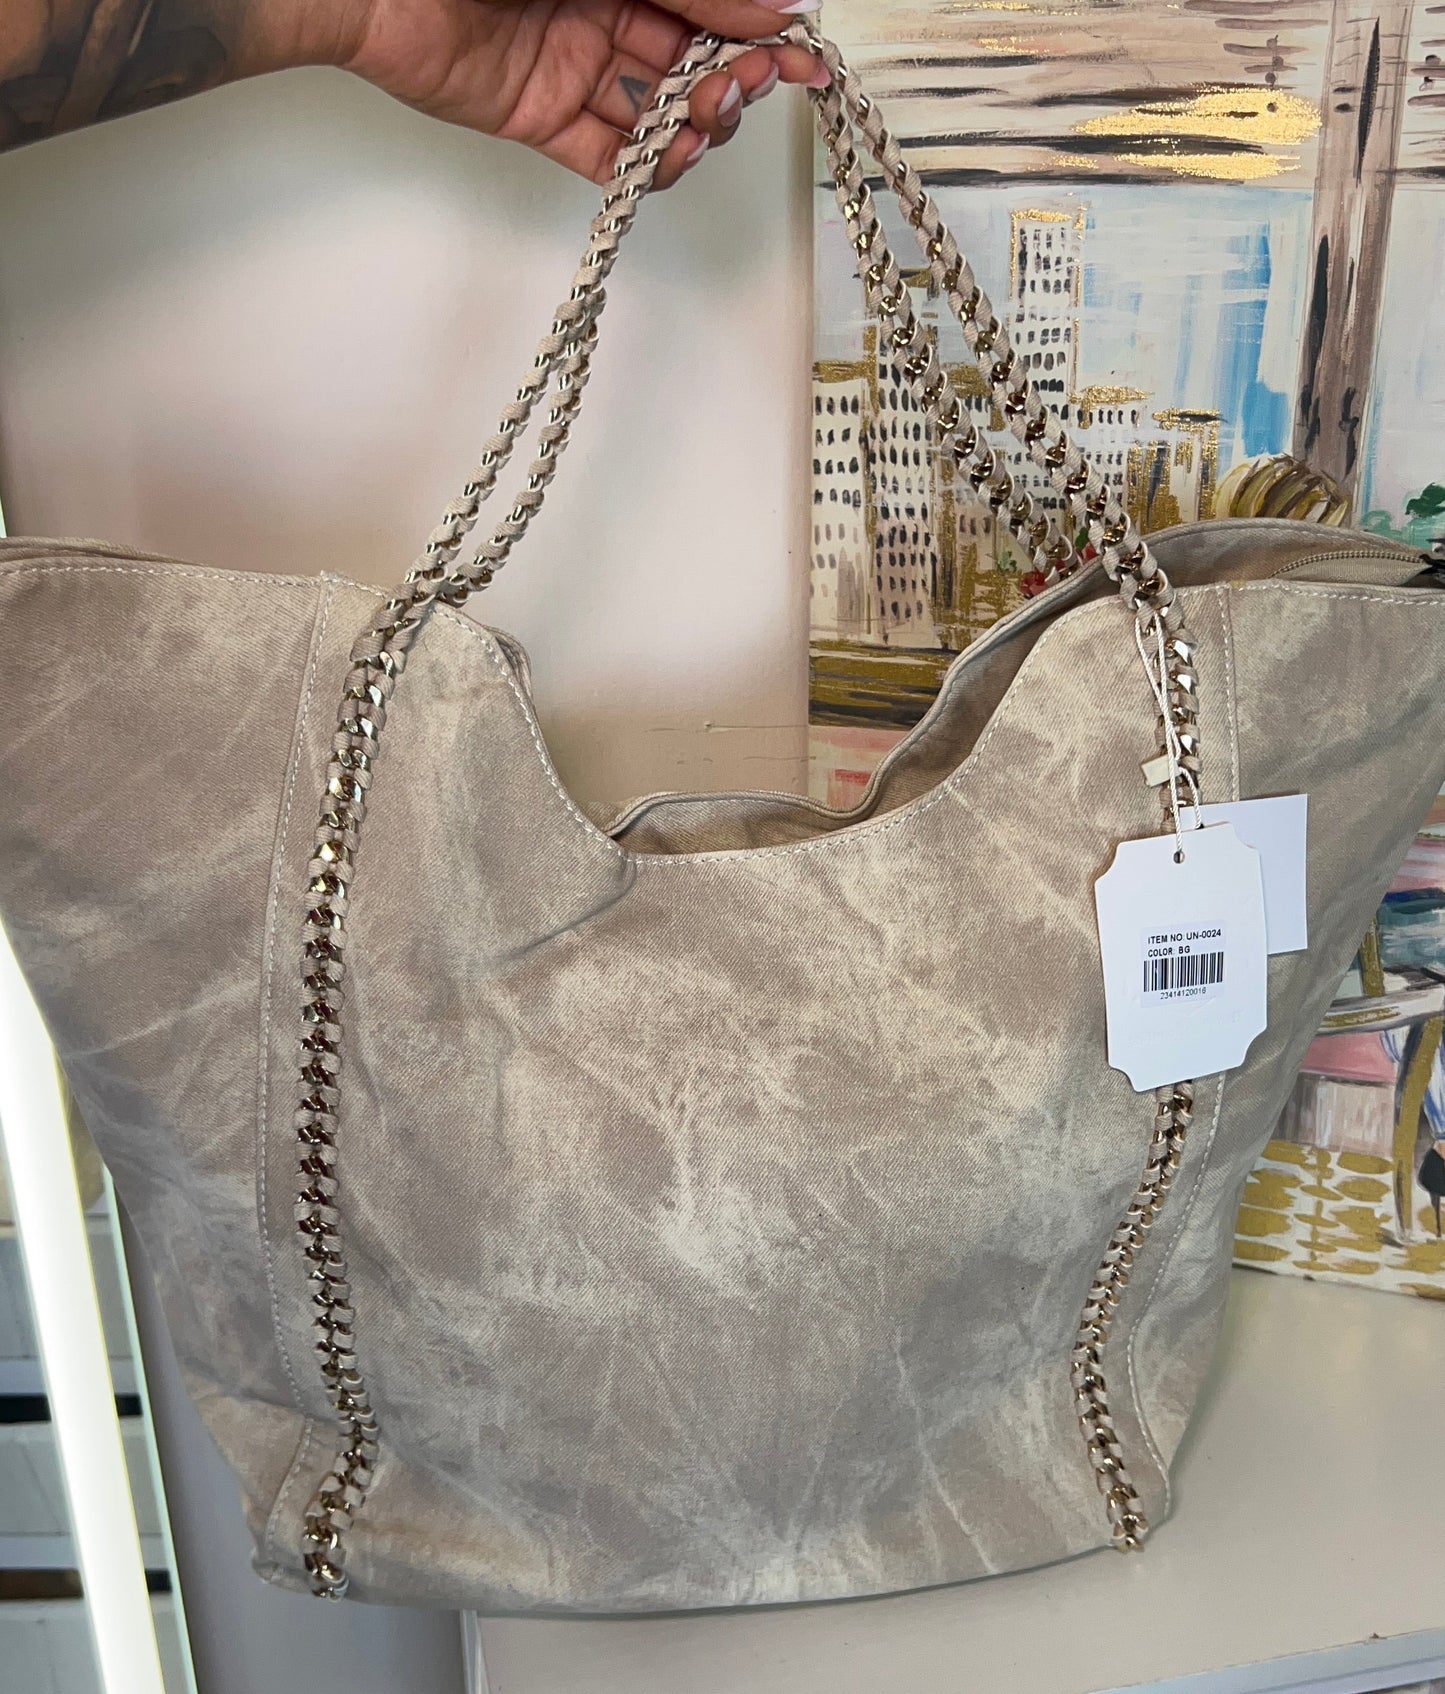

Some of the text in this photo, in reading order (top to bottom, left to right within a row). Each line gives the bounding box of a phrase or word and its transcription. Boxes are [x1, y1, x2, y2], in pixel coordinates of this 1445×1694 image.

[1148, 934, 1168, 944] ITEM
[1186, 928, 1221, 940] UN-0024
[1178, 945, 1191, 954] BG
